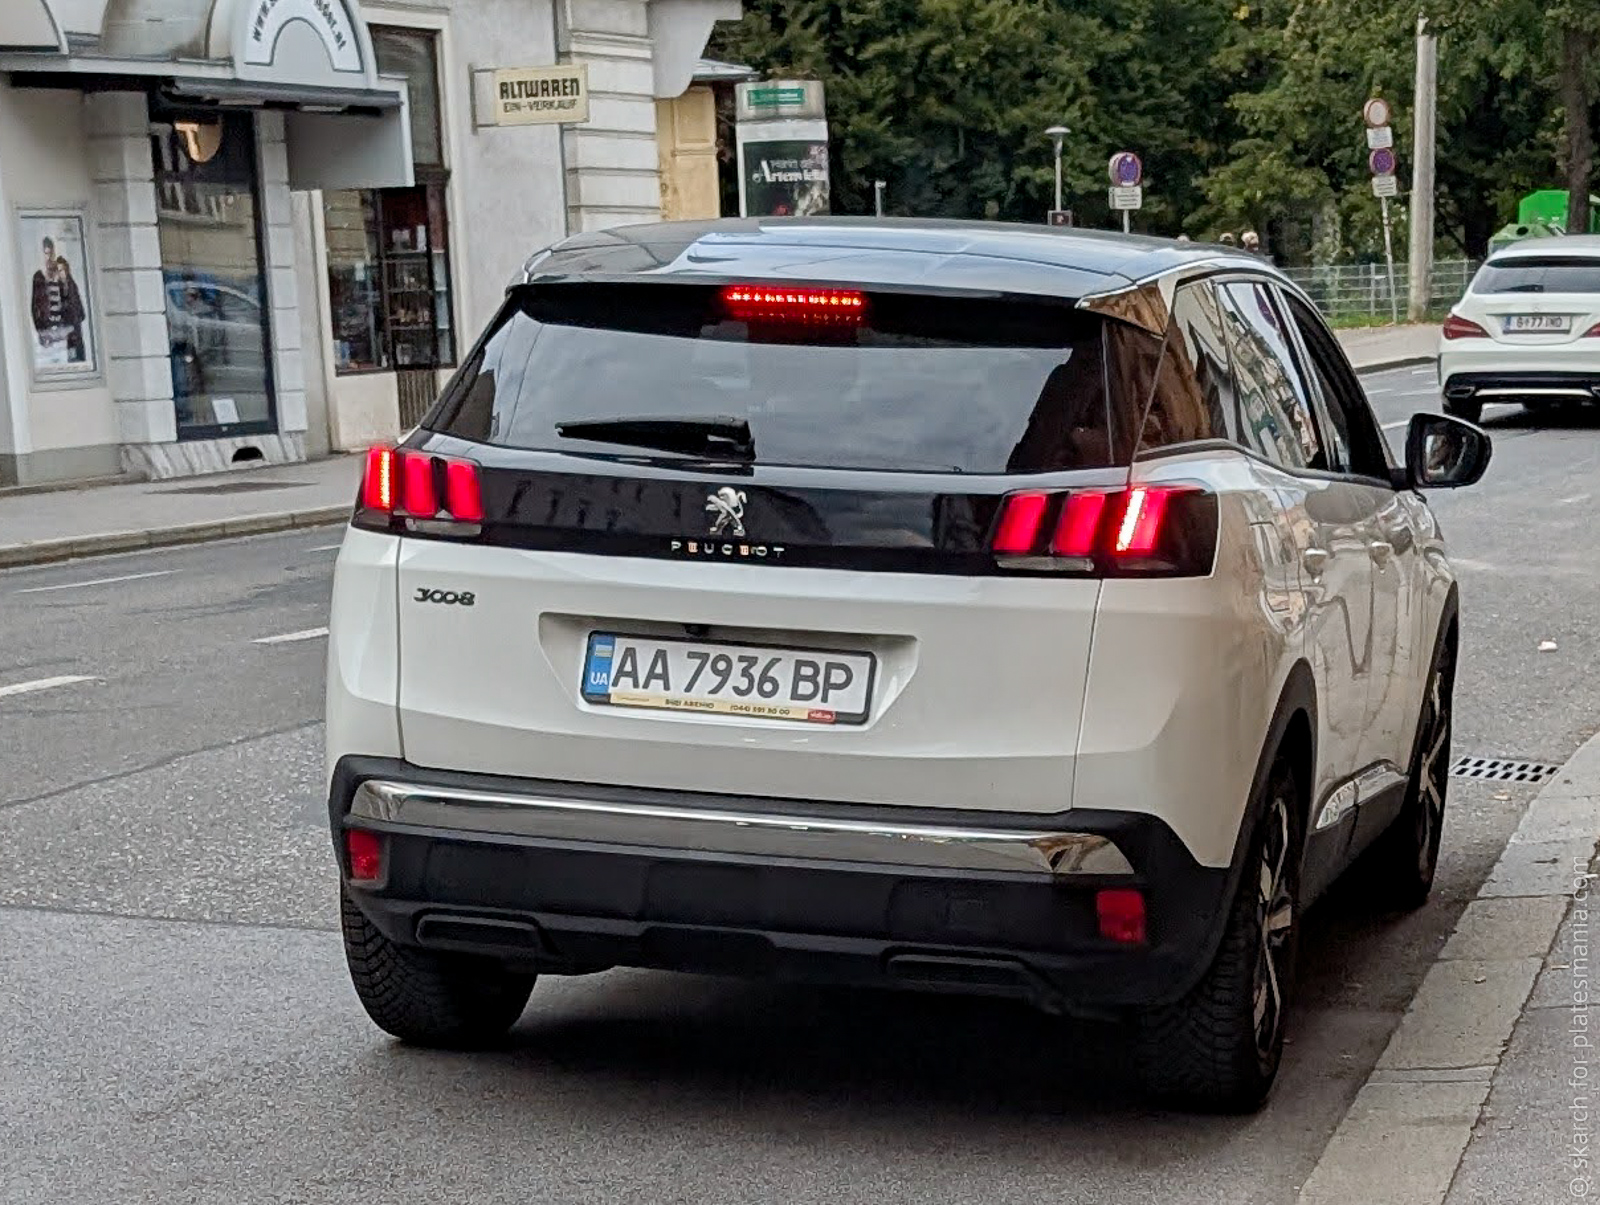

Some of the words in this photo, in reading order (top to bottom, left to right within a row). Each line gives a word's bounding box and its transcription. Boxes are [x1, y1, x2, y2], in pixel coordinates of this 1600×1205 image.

[499, 77, 580, 100] ALTWAREN
[670, 540, 785, 558] PEUGEOT
[413, 587, 476, 606] 3008
[590, 671, 609, 686] UA
[611, 646, 671, 691] AA
[683, 650, 782, 699] 7936
[790, 658, 854, 704] BP
